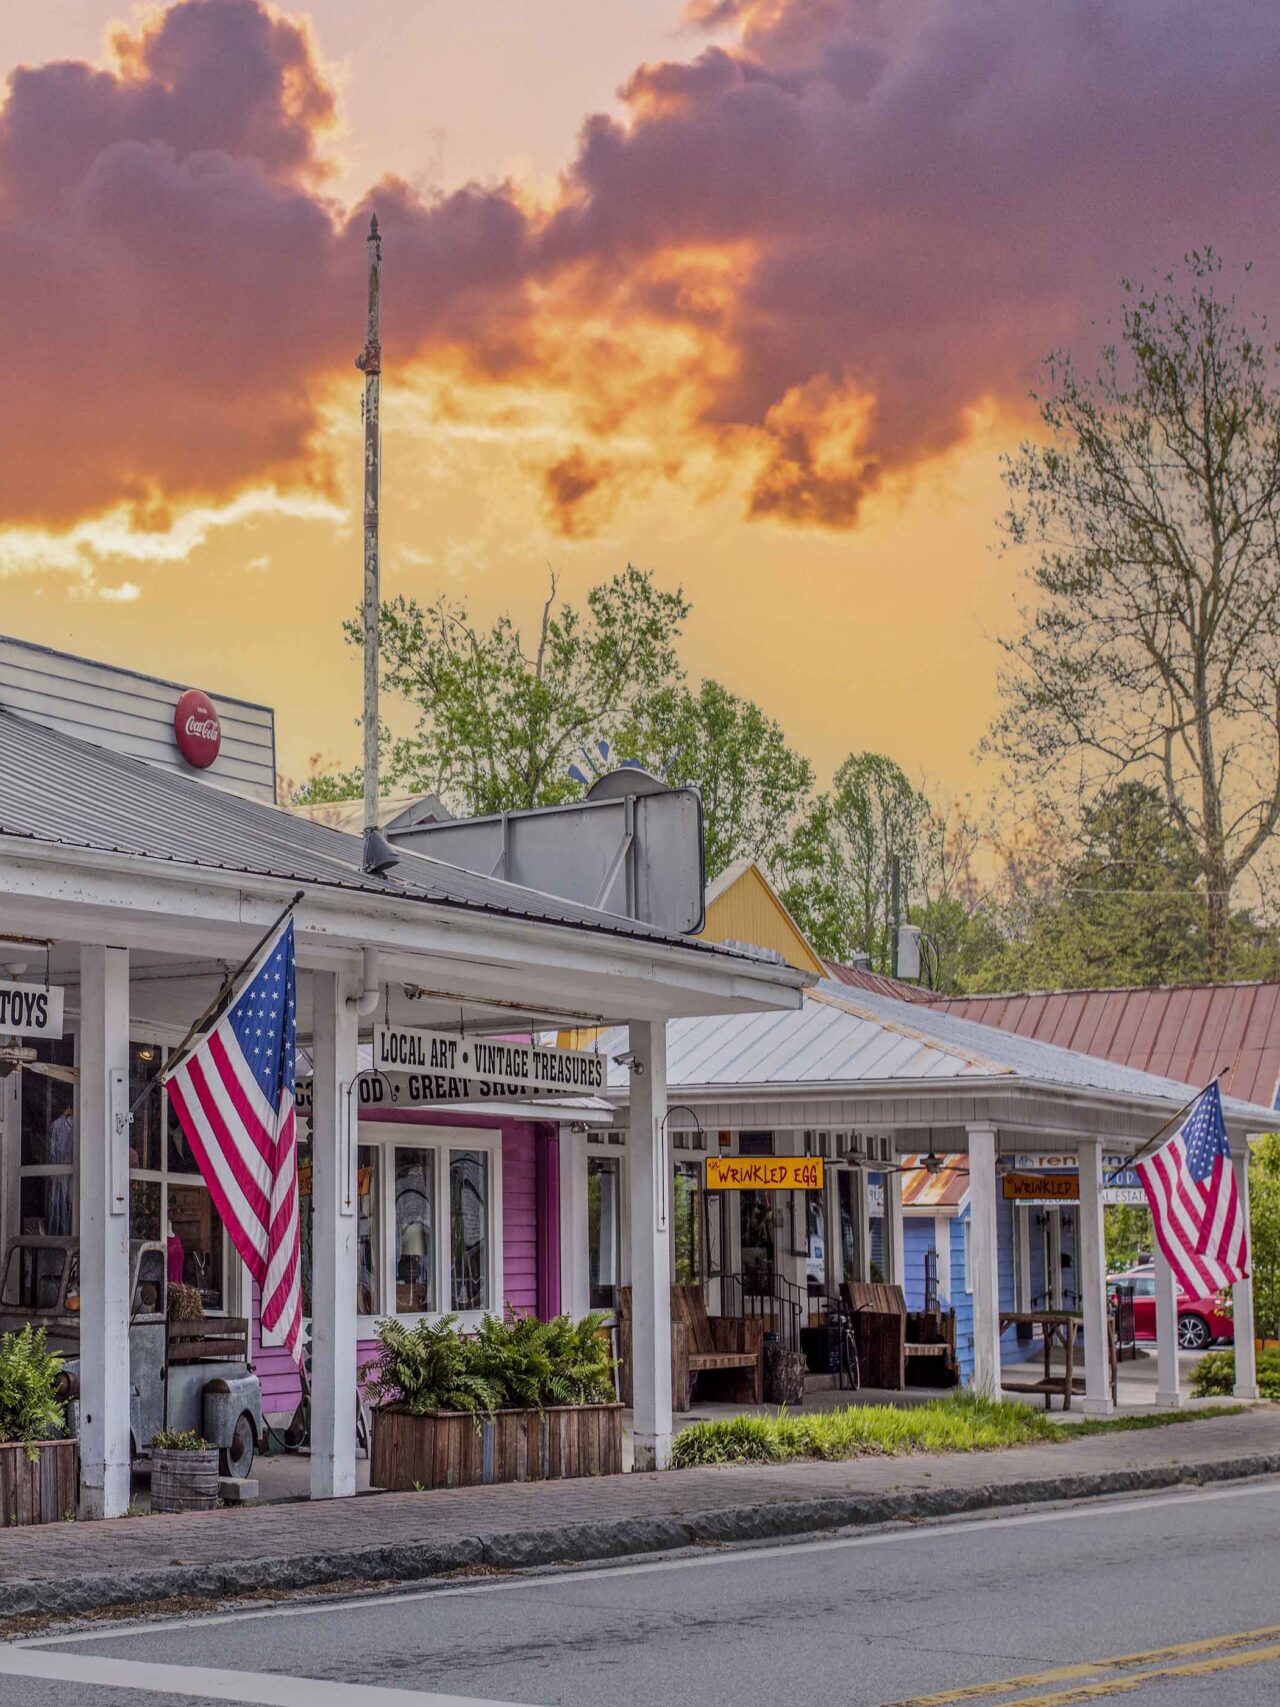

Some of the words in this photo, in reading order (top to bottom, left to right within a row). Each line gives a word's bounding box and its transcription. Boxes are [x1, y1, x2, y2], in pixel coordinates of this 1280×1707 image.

[185, 715, 219, 742] Coca-Cola
[380, 1031, 426, 1066] LOCAL
[430, 1037, 457, 1070] ART
[474, 1043, 529, 1079] VINTAGE
[532, 1051, 602, 1088] TREASURES
[408, 1073, 472, 1100] GREAT
[718, 1164, 788, 1185] WRINKLED
[793, 1164, 818, 1188] EGG
[1013, 1180, 1072, 1196] WRINKLED
